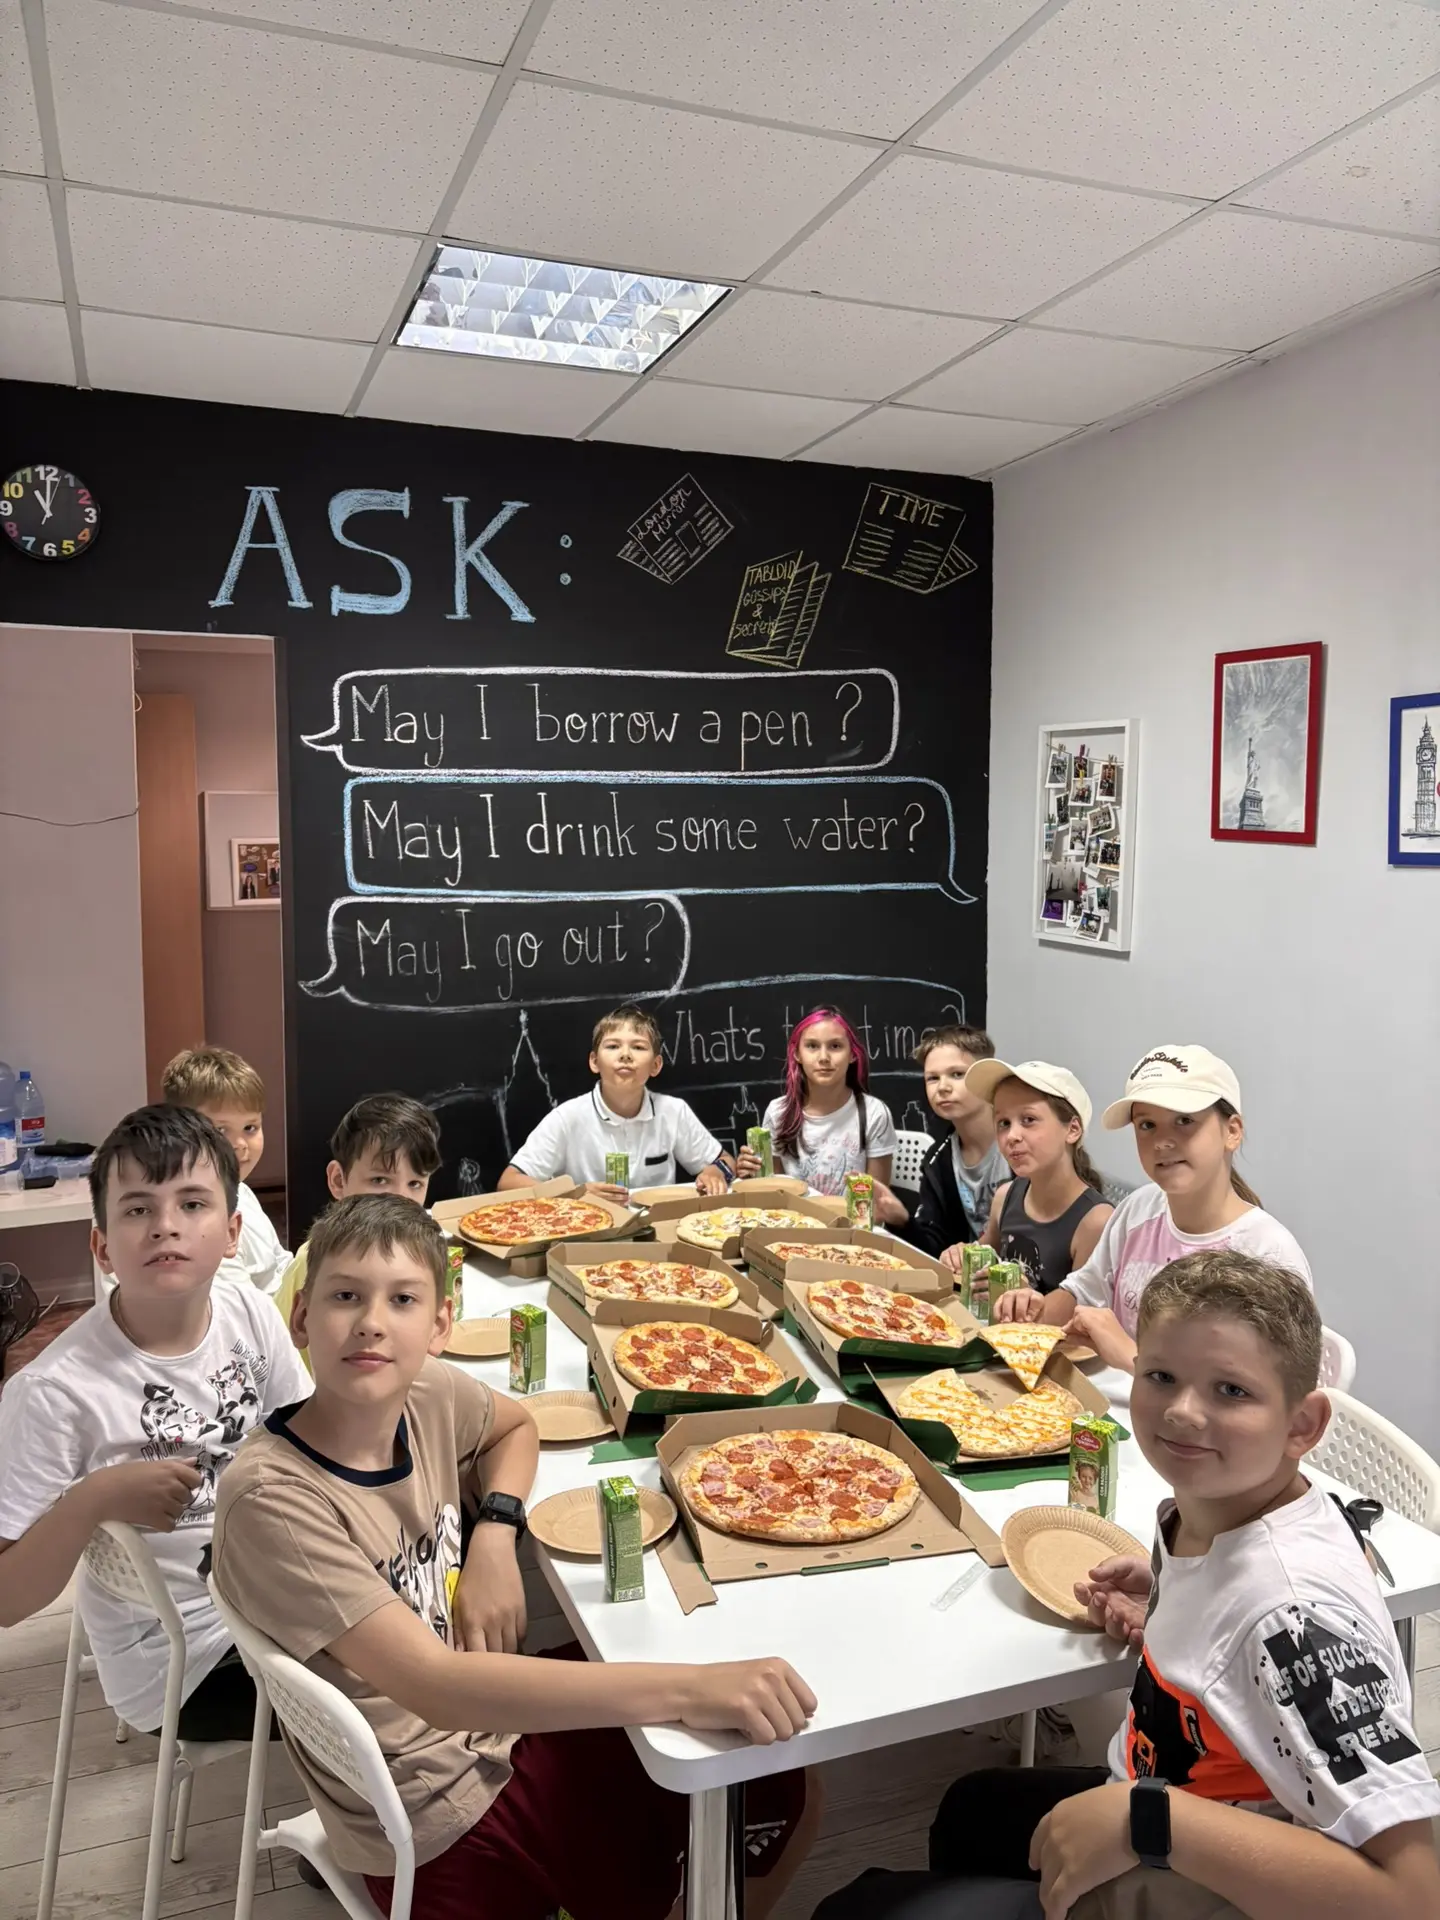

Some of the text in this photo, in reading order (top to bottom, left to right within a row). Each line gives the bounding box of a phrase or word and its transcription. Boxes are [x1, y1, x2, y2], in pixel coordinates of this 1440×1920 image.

[16, 467, 32, 483] 11
[34, 465, 60, 481] 12
[64, 473, 75, 487] 1
[3, 481, 24, 498] 10
[77, 489, 92, 505] 2
[0, 500, 13, 516] 9
[84, 507, 98, 523] 3
[878, 489, 945, 527] TIME
[5, 522, 18, 538] 8
[77, 528, 91, 543] 4
[22, 536, 36, 551] 7
[43, 543, 57, 556] 6
[61, 540, 76, 554] 5
[748, 561, 797, 586] TABLOID
[752, 604, 763, 619] &
[351, 683, 444, 768] May
[474, 684, 491, 740] I
[525, 683, 680, 744] borrow
[699, 710, 721, 744] a
[741, 710, 812, 771] pen
[363, 791, 925, 887] May I drink some water?
[356, 918, 442, 1003] May
[455, 908, 476, 970] I
[495, 932, 543, 1000] go
[562, 911, 628, 965] out
[1292, 1653, 1318, 1688] OF
